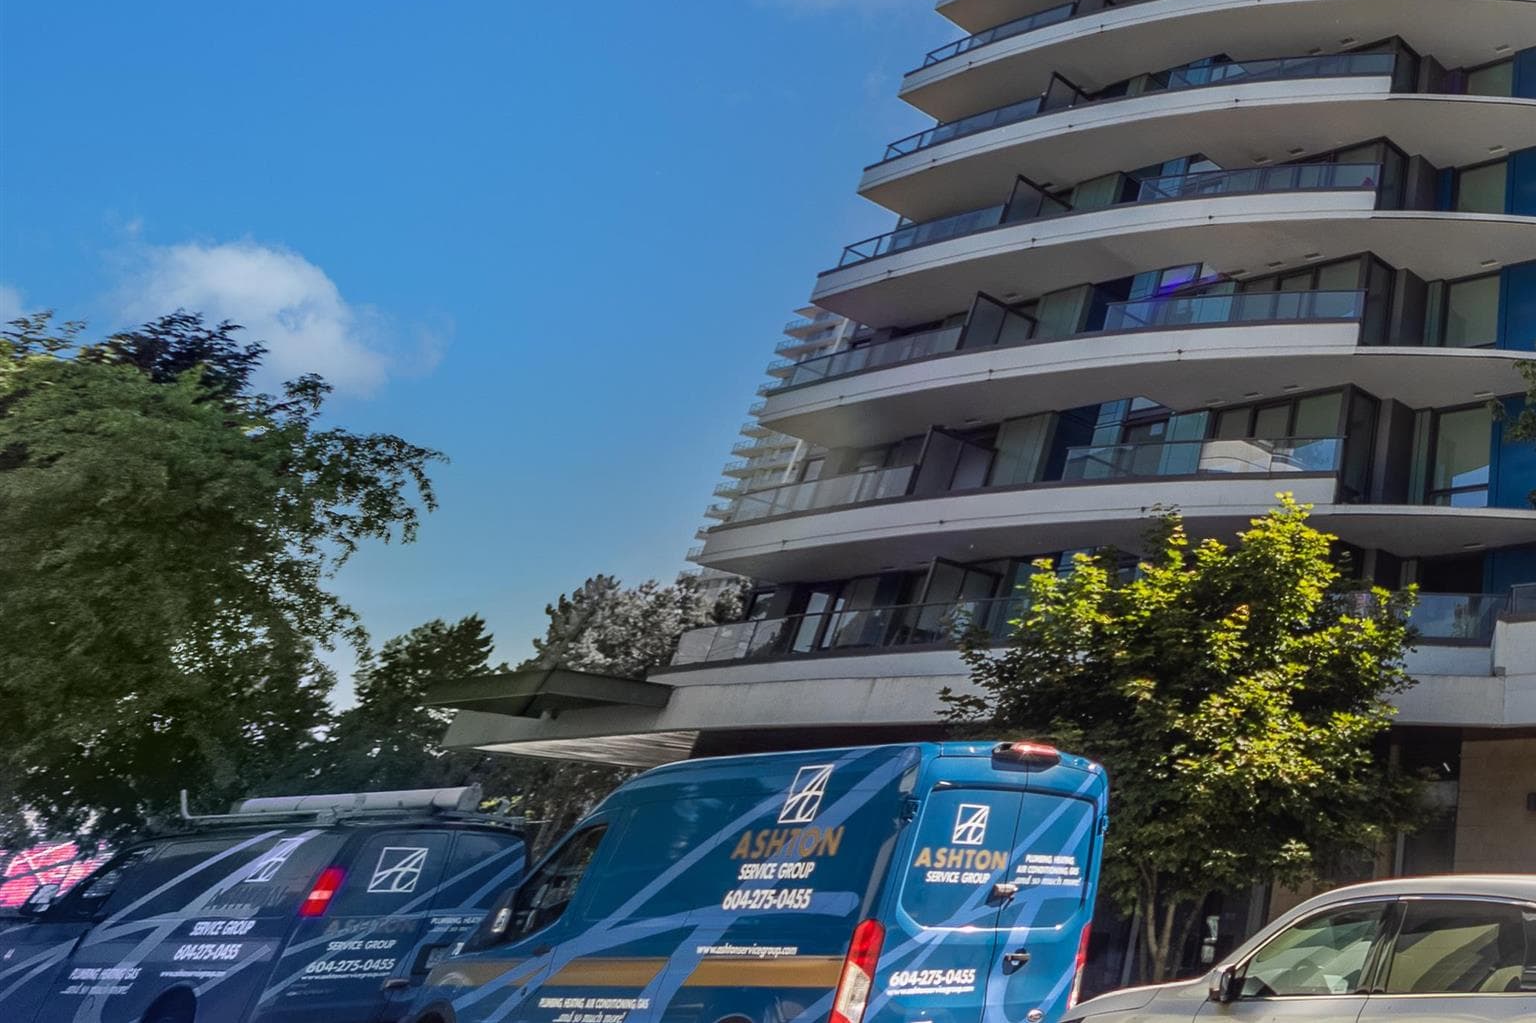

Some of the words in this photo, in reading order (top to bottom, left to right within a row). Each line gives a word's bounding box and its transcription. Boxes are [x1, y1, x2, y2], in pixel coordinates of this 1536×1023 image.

[730, 826, 845, 860] ASHTON
[913, 847, 1008, 870] ASHTON
[738, 863, 777, 880] SERVICE
[778, 862, 815, 879] GROUP
[925, 870, 960, 883] SERVICE
[961, 872, 991, 884] GROUP
[722, 888, 814, 910] 604-275-0455
[189, 920, 225, 936] SERVICE
[221, 920, 257, 936] GROUP
[173, 943, 243, 961] 604-275-0455
[326, 940, 362, 951] SERVICE
[364, 939, 398, 950] GROUP
[305, 958, 396, 974] 604-275-0455
[889, 968, 976, 987] 604-275-0455
